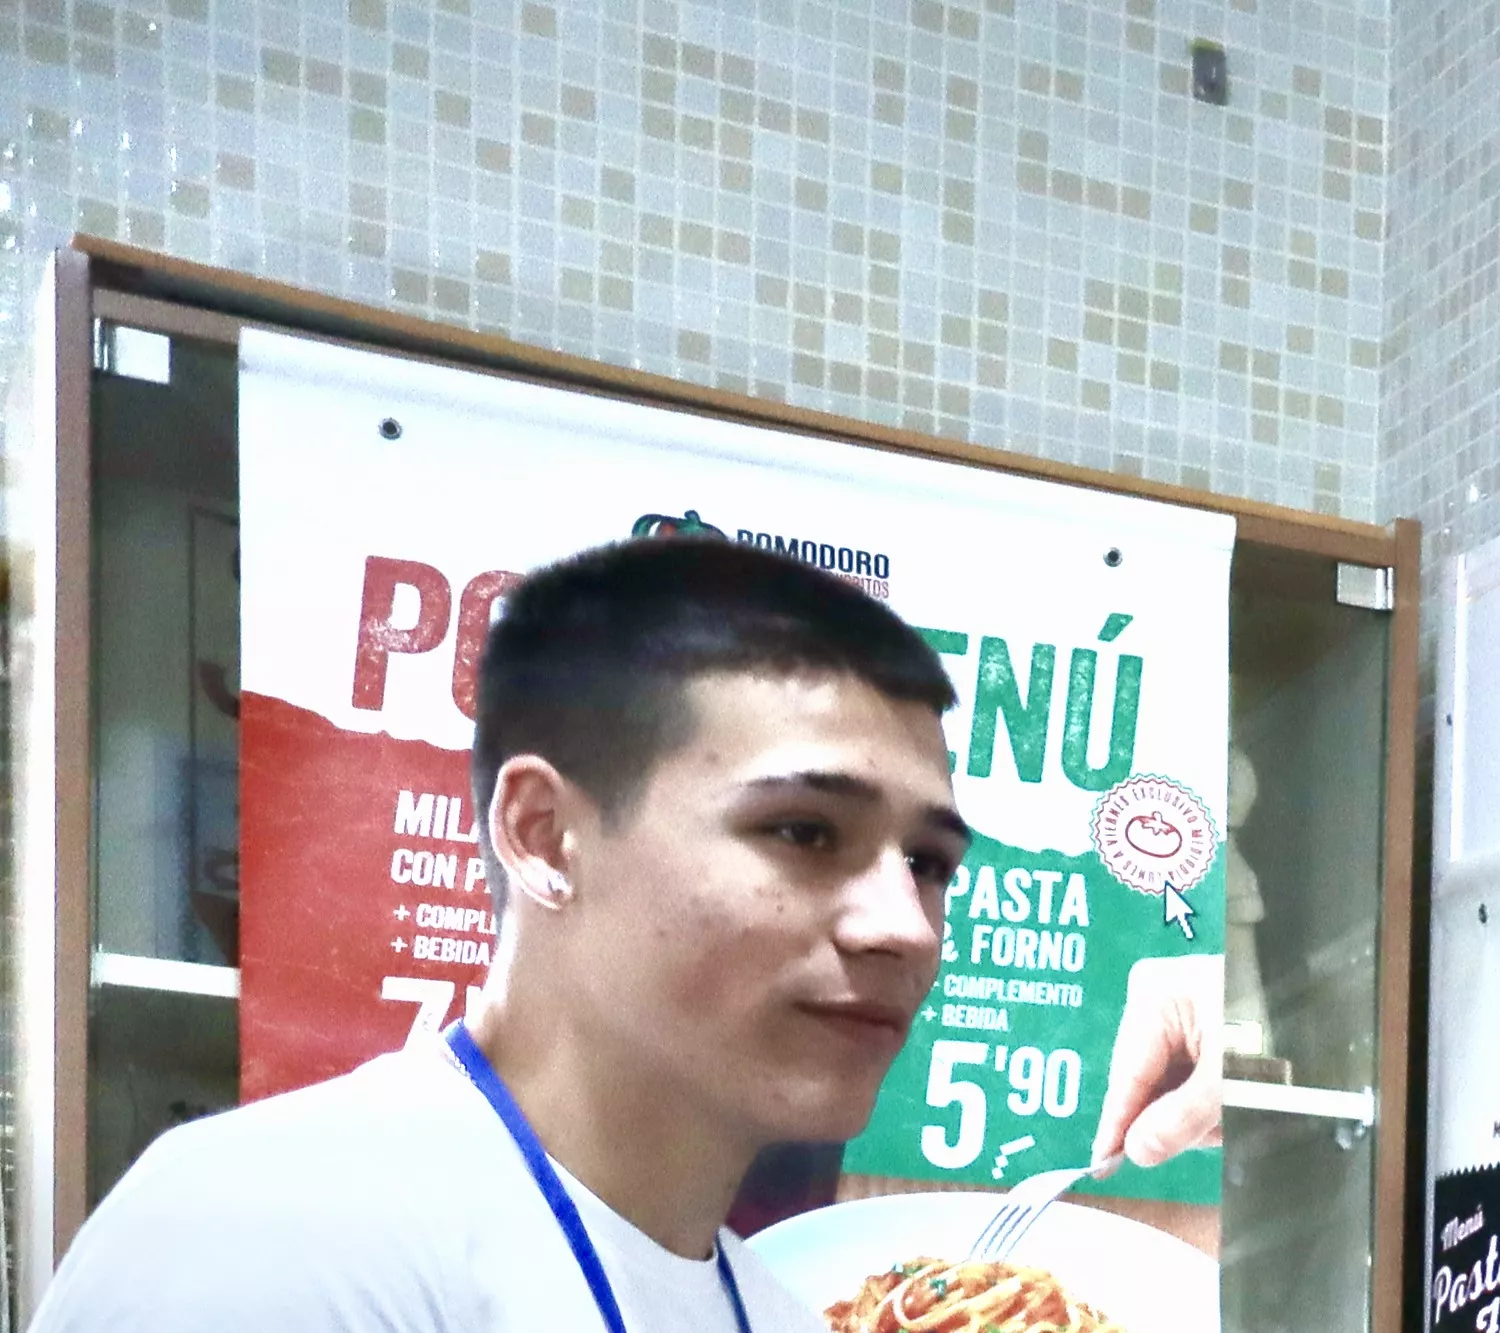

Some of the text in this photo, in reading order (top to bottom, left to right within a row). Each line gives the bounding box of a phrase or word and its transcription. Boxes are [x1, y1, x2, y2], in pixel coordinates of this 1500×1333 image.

[390, 848, 458, 890] CON
[944, 864, 1091, 927] PASTA
[413, 935, 491, 967] BEBIDA
[971, 924, 1086, 974] FORNO
[943, 973, 1084, 1009] COMPLEMENTO
[941, 1003, 1010, 1033] BEBIDA
[920, 1040, 1081, 1169] 5'90
